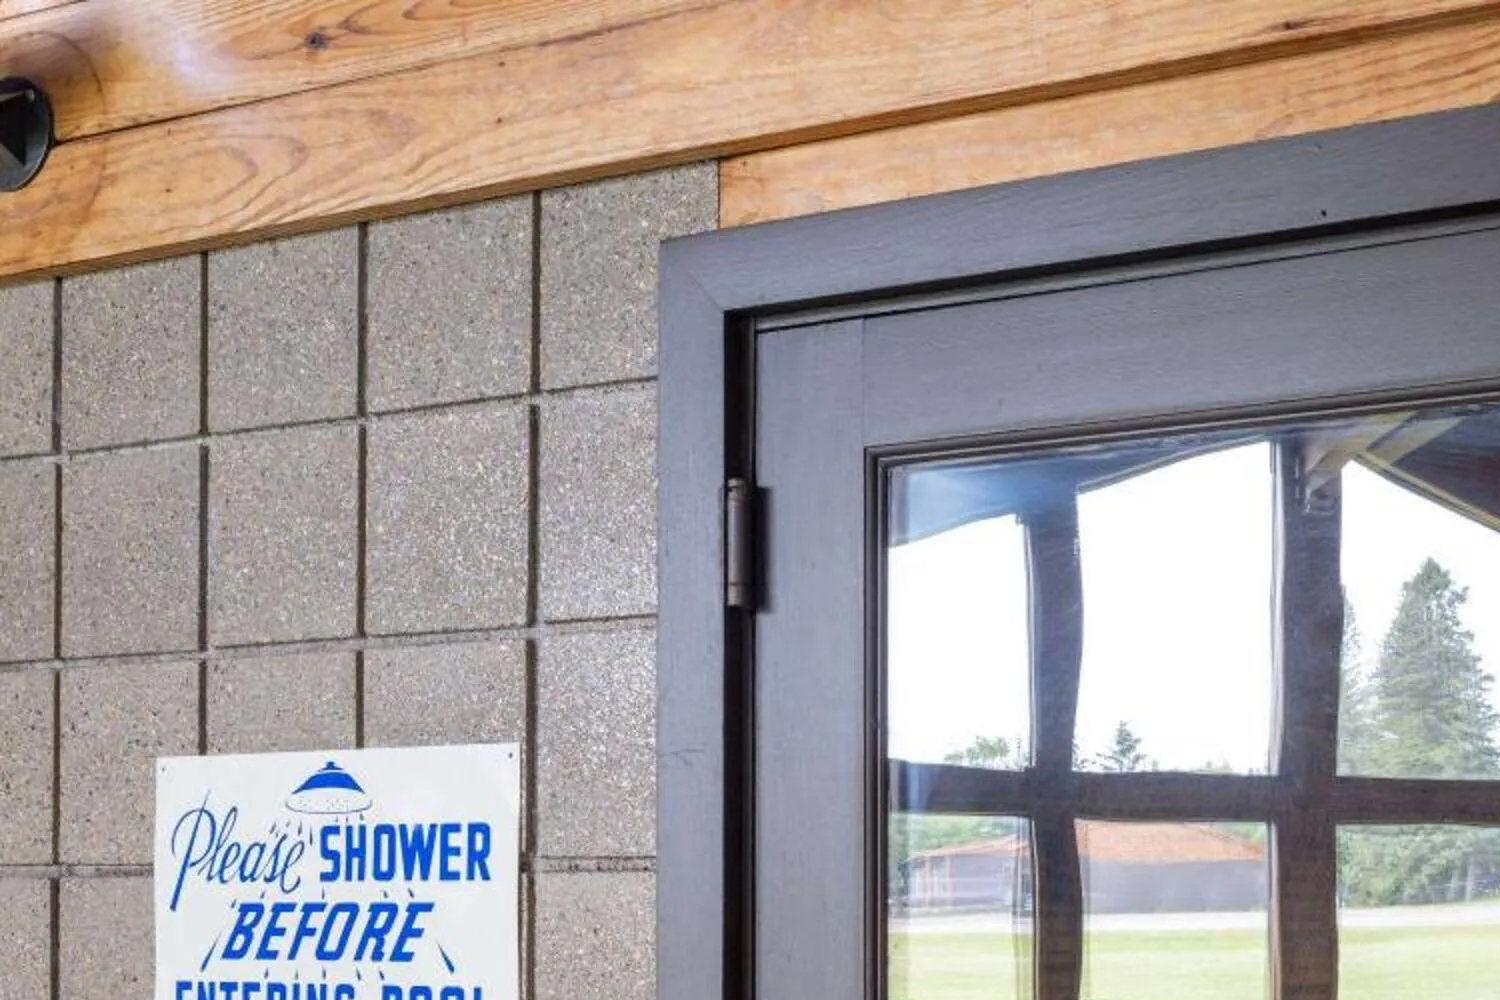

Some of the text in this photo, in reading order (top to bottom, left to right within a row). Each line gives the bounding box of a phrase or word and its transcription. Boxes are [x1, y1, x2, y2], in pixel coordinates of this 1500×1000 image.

[170, 789, 492, 911] Please SHOWER
[221, 901, 435, 963] BEFORE
